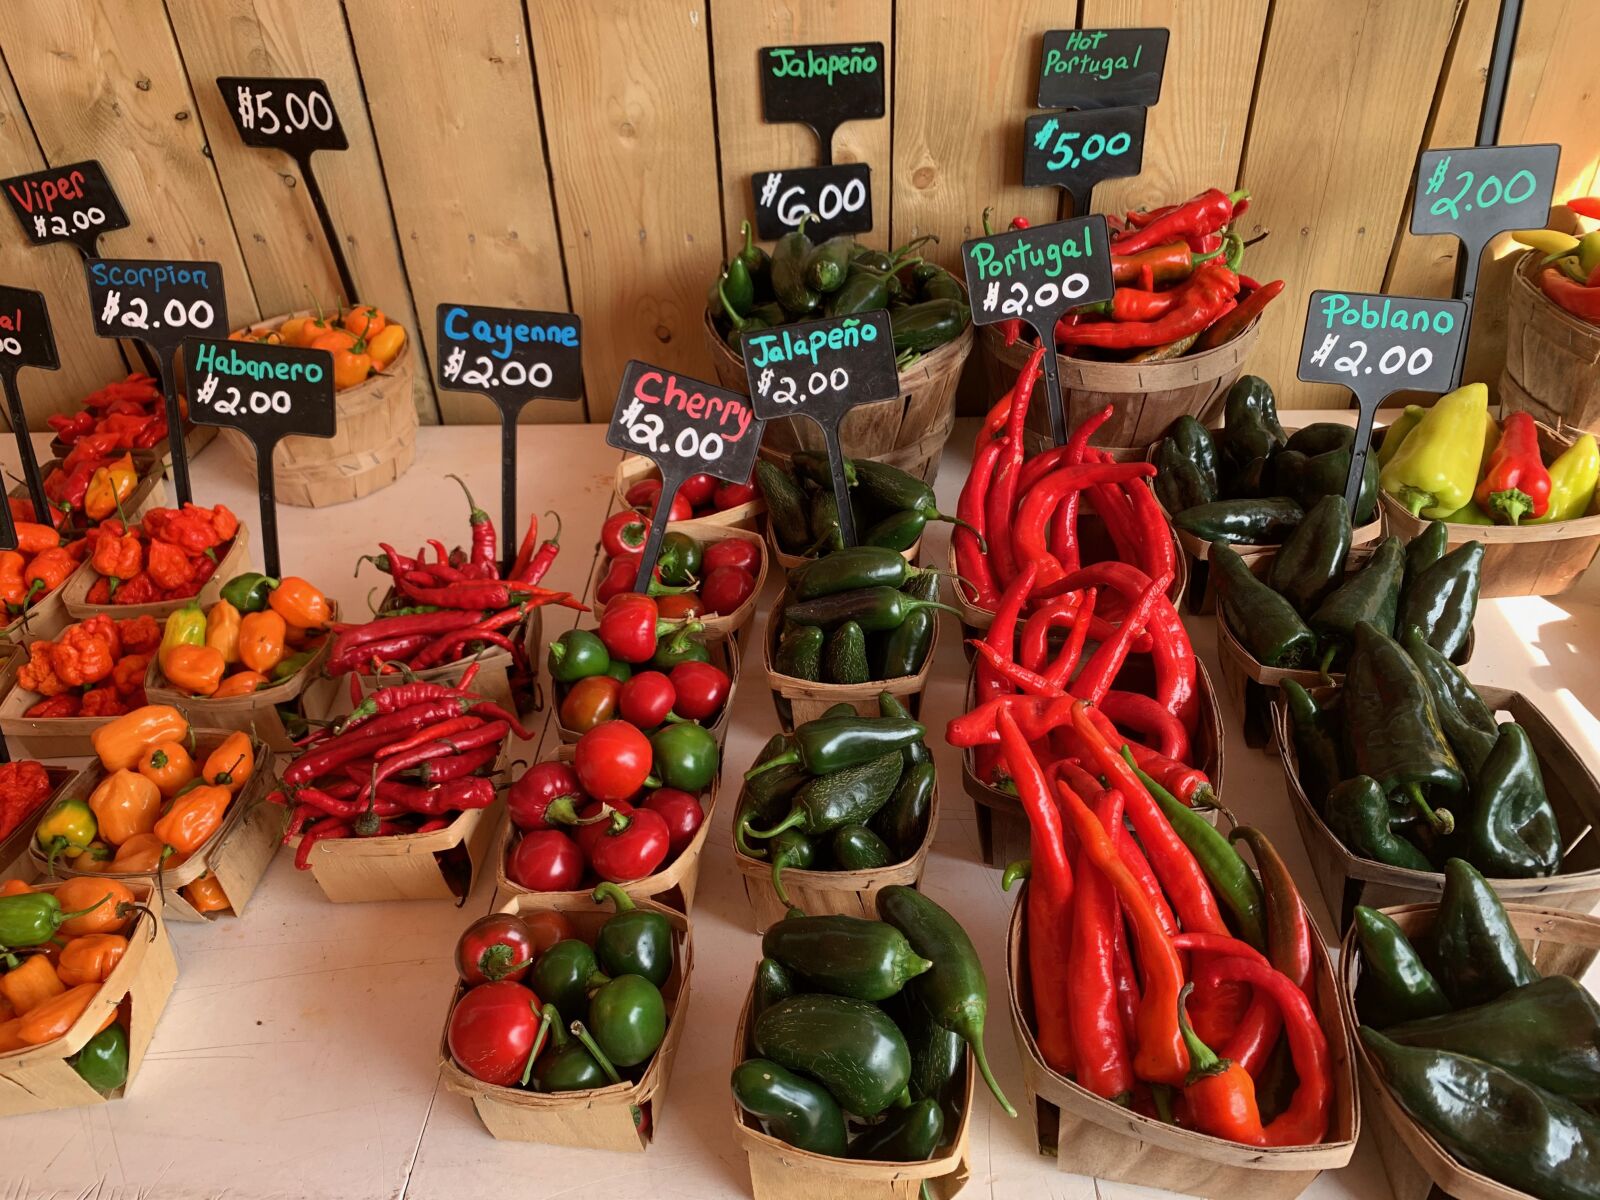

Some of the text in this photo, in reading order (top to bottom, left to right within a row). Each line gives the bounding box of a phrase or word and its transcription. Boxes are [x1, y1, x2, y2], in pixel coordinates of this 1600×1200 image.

[1043, 44, 1142, 80] Portugal
[1065, 31, 1108, 51] Hot
[769, 48, 878, 86] Jalapeño
[237, 85, 334, 135] $5.00
[1033, 117, 1131, 171] $5.00
[8, 171, 85, 213] Viper
[760, 172, 866, 226] $600
[1425, 156, 1537, 220] $2.00
[33, 207, 106, 238] $2.00
[970, 226, 1093, 278] Portugal
[92, 263, 209, 293] Scorpion
[982, 272, 1090, 317] $2.00
[101, 289, 215, 330] $2.00
[1320, 293, 1454, 336] Poblano
[444, 307, 580, 359] Cayenne
[748, 318, 878, 367] Jalapeño
[196, 344, 323, 383] Habanero
[443, 346, 553, 389] $2.00
[1309, 332, 1434, 378] $2.00
[197, 373, 292, 416] $2.00
[633, 371, 753, 443] Cherry
[757, 367, 849, 405] $2.00
[618, 396, 724, 461] $2.00
